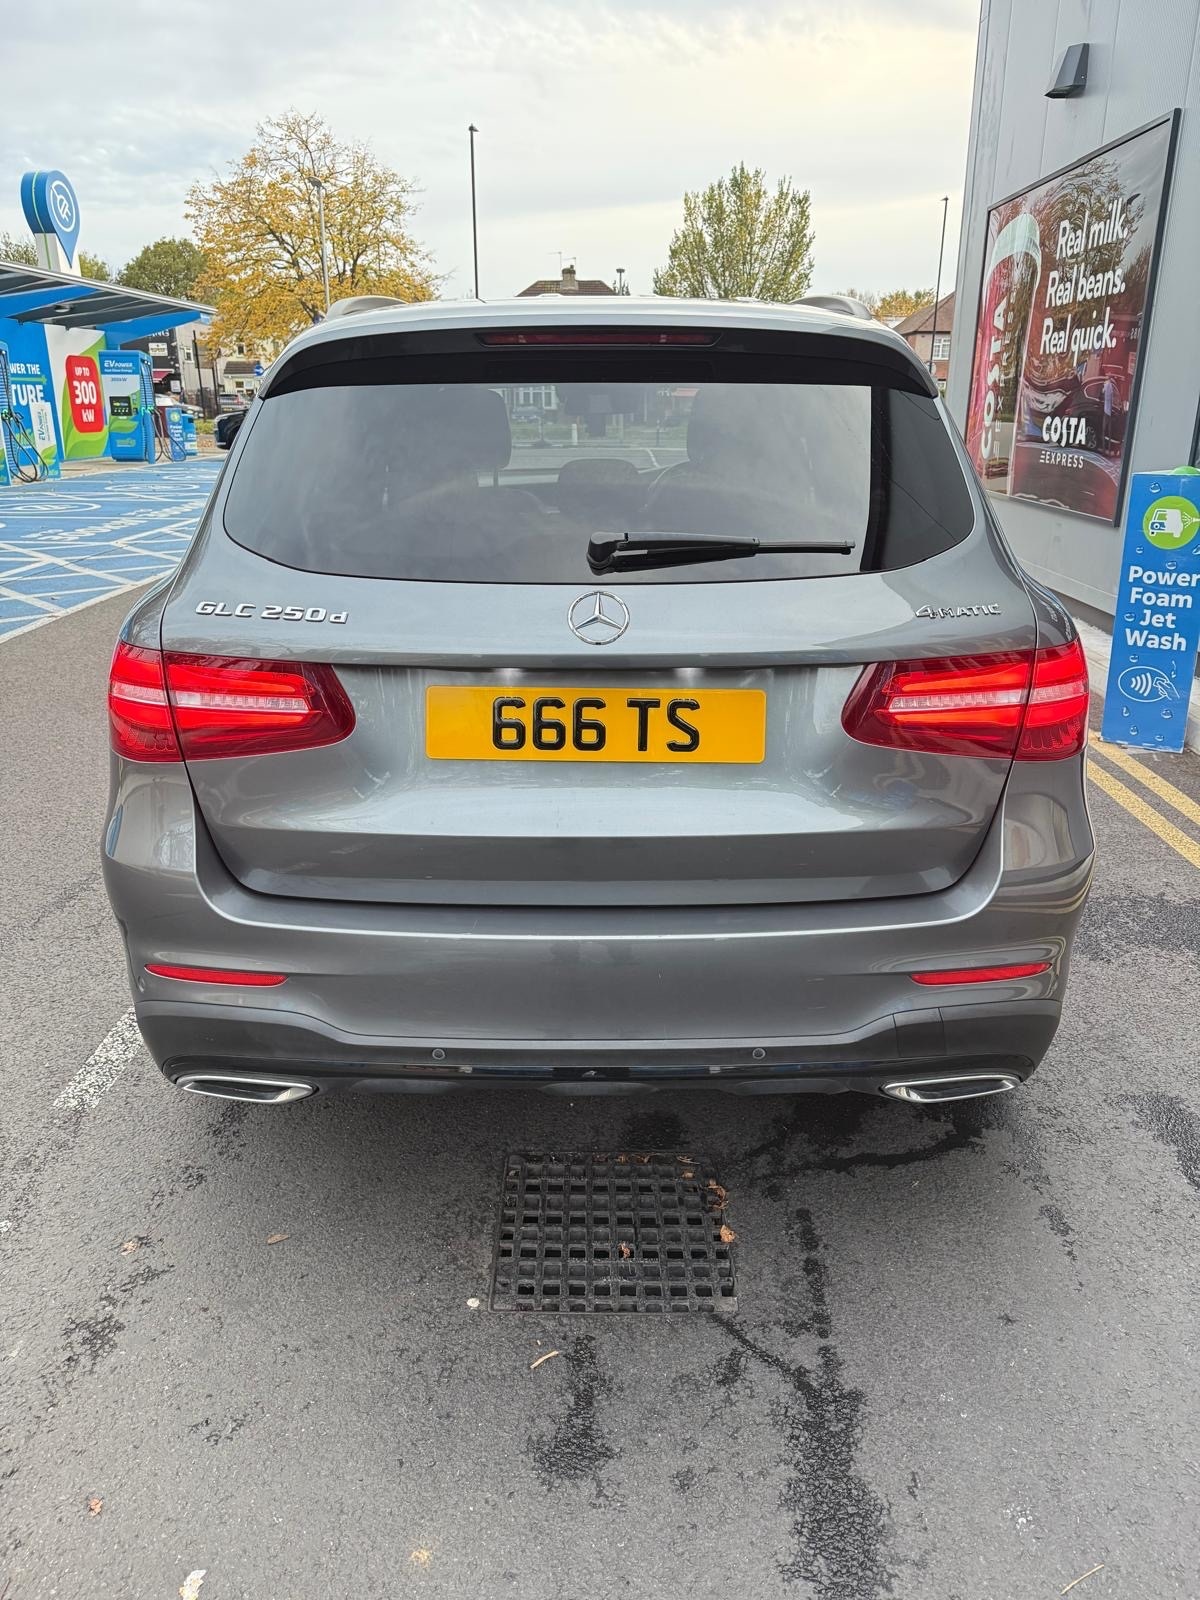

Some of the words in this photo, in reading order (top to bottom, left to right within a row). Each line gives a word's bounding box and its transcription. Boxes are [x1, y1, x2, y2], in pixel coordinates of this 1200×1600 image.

[1056, 210, 1089, 260] Real
[1088, 198, 1128, 249] milk.
[1045, 264, 1077, 308] Real
[1077, 262, 1126, 302] beans.
[1040, 314, 1071, 355] Real
[1071, 307, 1117, 367] quick.
[26, 363, 40, 375] THE
[74, 367, 82, 377] UP
[82, 367, 90, 377] TO
[73, 380, 97, 405] 300
[82, 409, 95, 423] kW
[1042, 415, 1086, 447] COSTA
[1045, 451, 1084, 469] EXPRESS
[1128, 565, 1200, 587] Power
[1130, 587, 1193, 608] Foam
[195, 601, 256, 617] GLC
[915, 604, 1002, 619] 4MATIC
[1139, 609, 1176, 629] Jet
[1125, 628, 1187, 651] Wash
[492, 696, 607, 751] 666
[627, 697, 701, 753] TS
